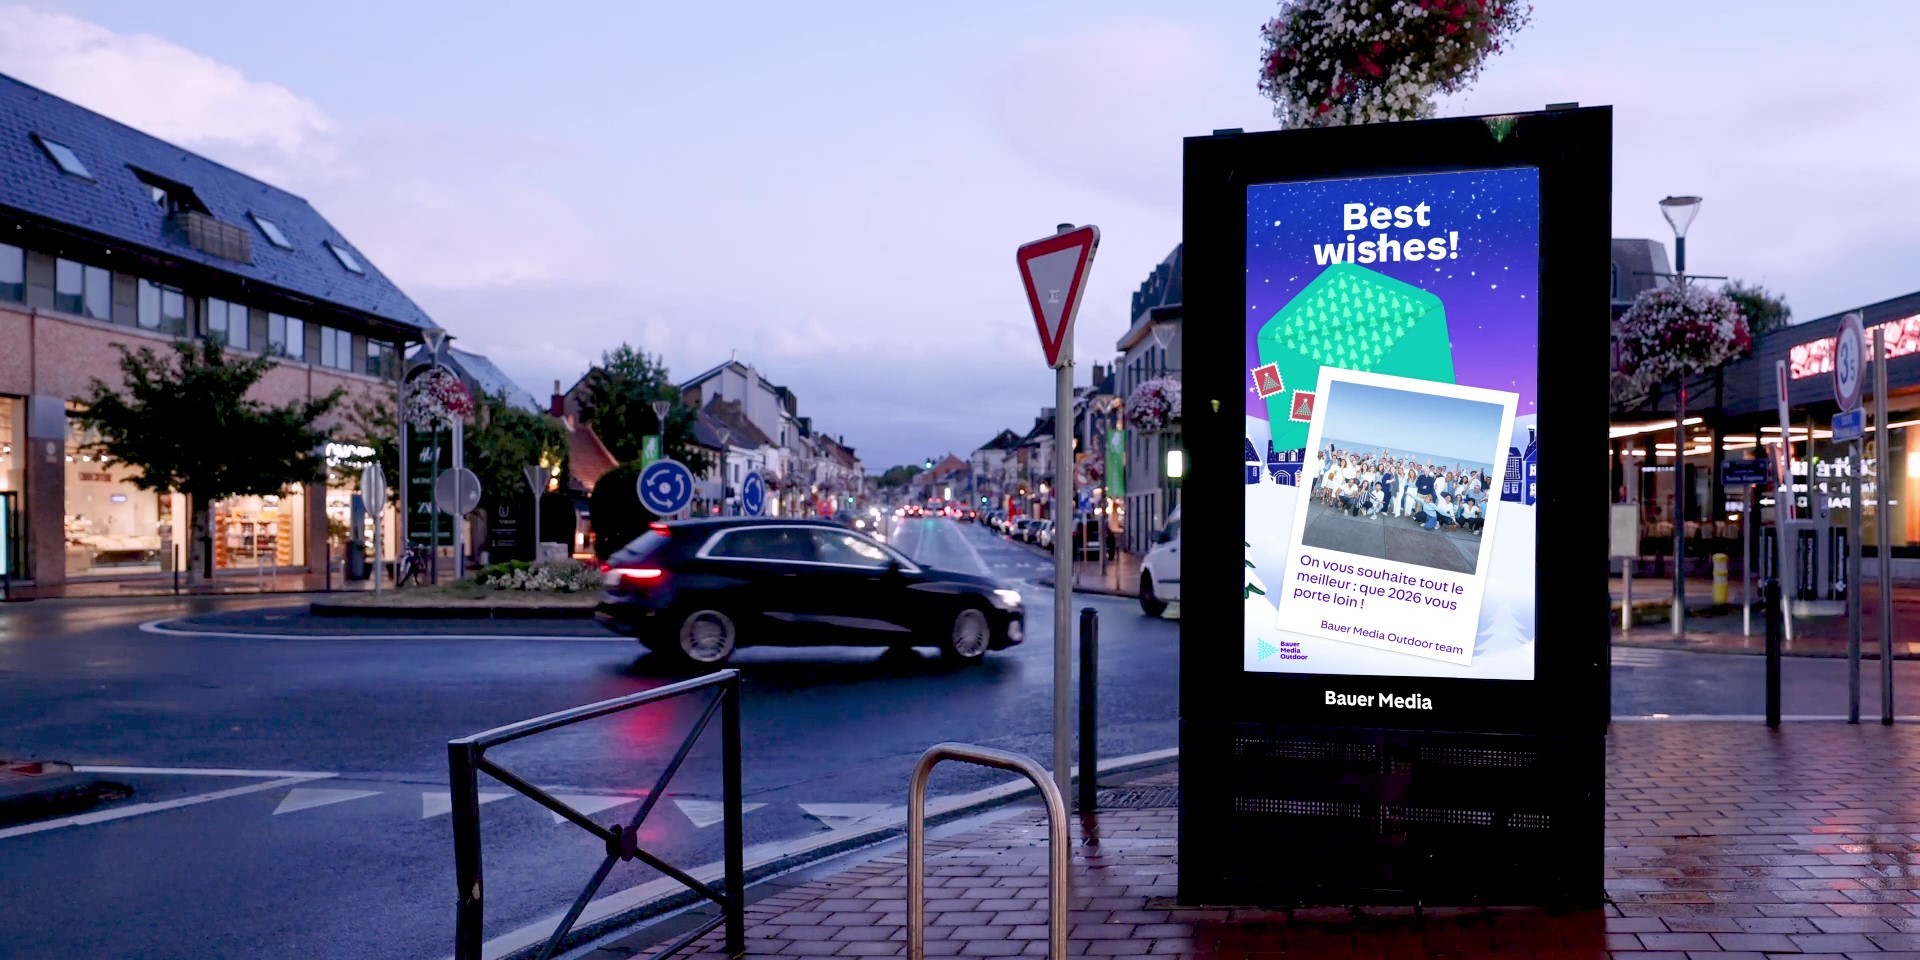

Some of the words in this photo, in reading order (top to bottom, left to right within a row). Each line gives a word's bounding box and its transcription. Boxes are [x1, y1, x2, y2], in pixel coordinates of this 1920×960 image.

[1344, 201, 1430, 231] Best
[1313, 231, 1458, 265] wishes!
[1297, 571, 1351, 590] meilleur
[1359, 584, 1385, 597] que
[1388, 587, 1422, 604] 2026
[1424, 595, 1457, 610] vous
[1300, 555, 1319, 568] On
[1323, 561, 1354, 574] vous
[1356, 567, 1416, 586] souhaite
[1419, 577, 1449, 593] tout
[1451, 582, 1464, 595] le
[1293, 587, 1330, 602] porte
[1333, 592, 1358, 608] loin
[1320, 620, 1351, 634] Bauer
[1353, 626, 1385, 640] Media
[1387, 633, 1433, 649] Outdoor
[1435, 643, 1463, 655] team
[1325, 690, 1374, 707] Bauer
[1378, 692, 1433, 710] Media
